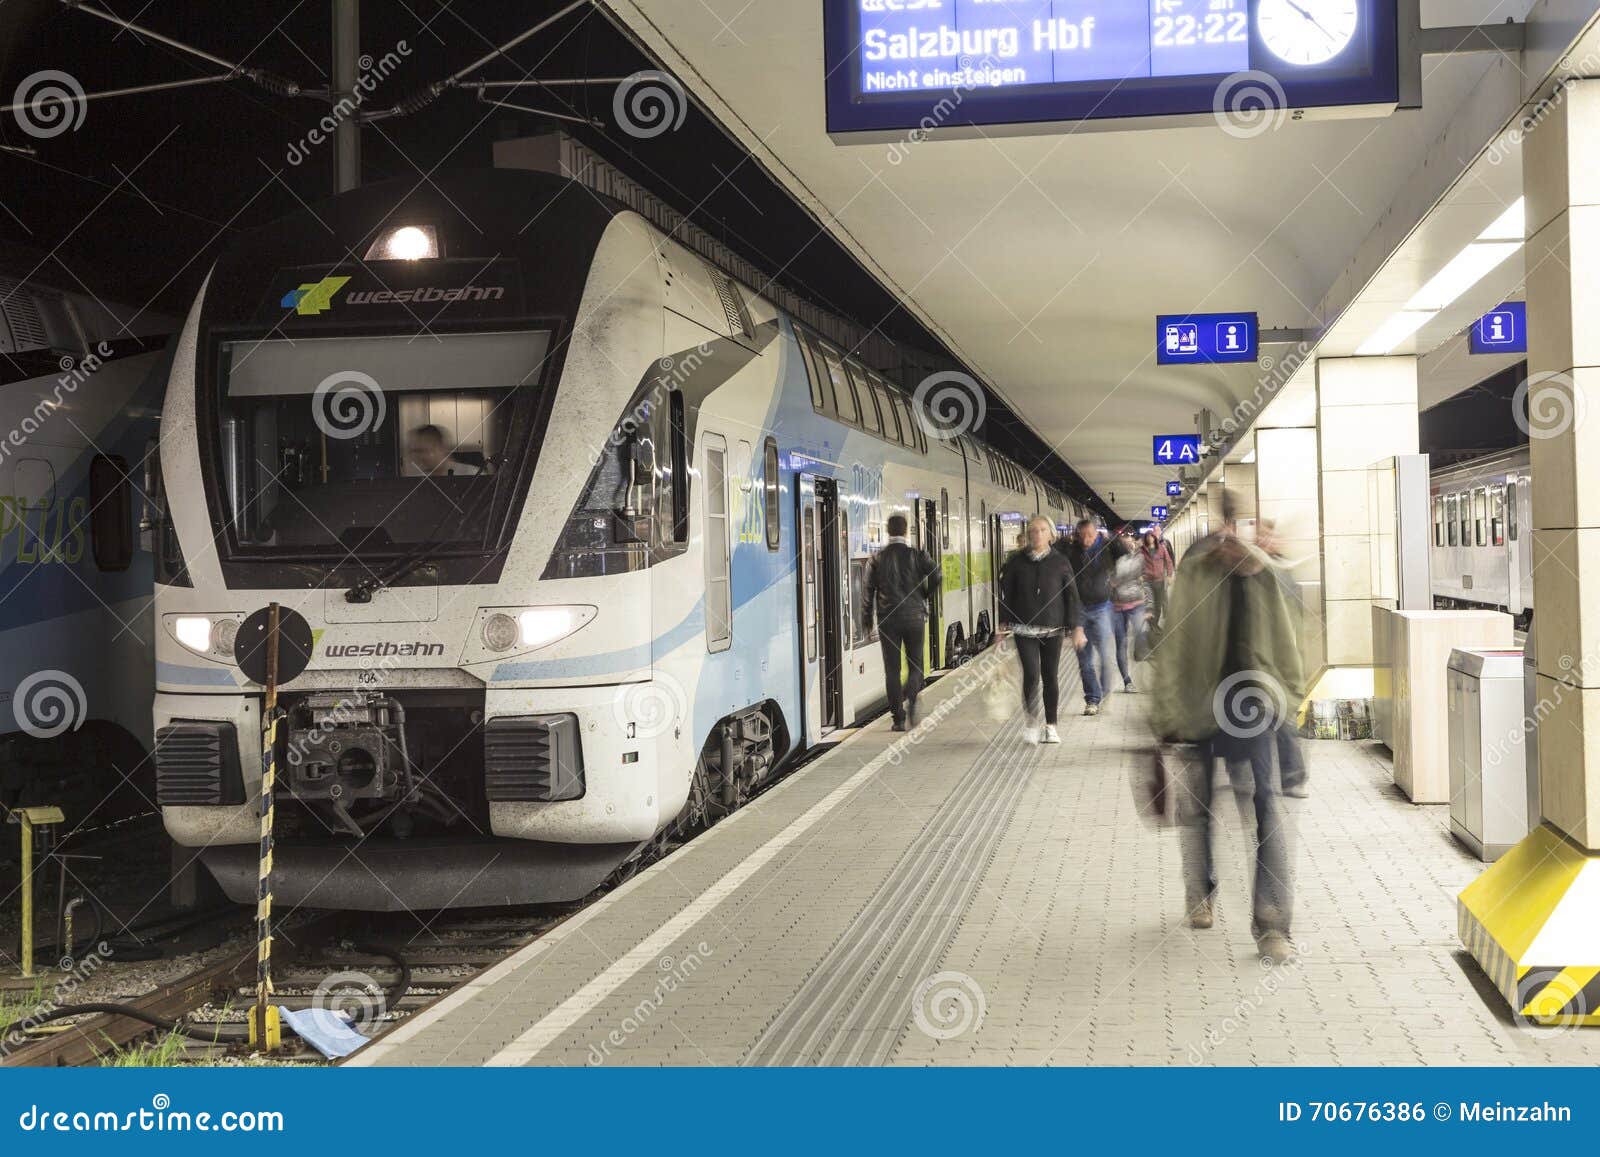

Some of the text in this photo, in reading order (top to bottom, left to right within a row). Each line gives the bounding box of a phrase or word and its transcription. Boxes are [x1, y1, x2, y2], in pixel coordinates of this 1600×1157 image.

[865, 17, 1095, 60] Salzburg Hbf
[1154, 13, 1247, 46] 22:22
[866, 68, 1026, 90] Nicht einsteigen
[346, 286, 505, 305] westbahn
[1157, 440, 1194, 460] 4 A
[325, 642, 444, 657] westbahn
